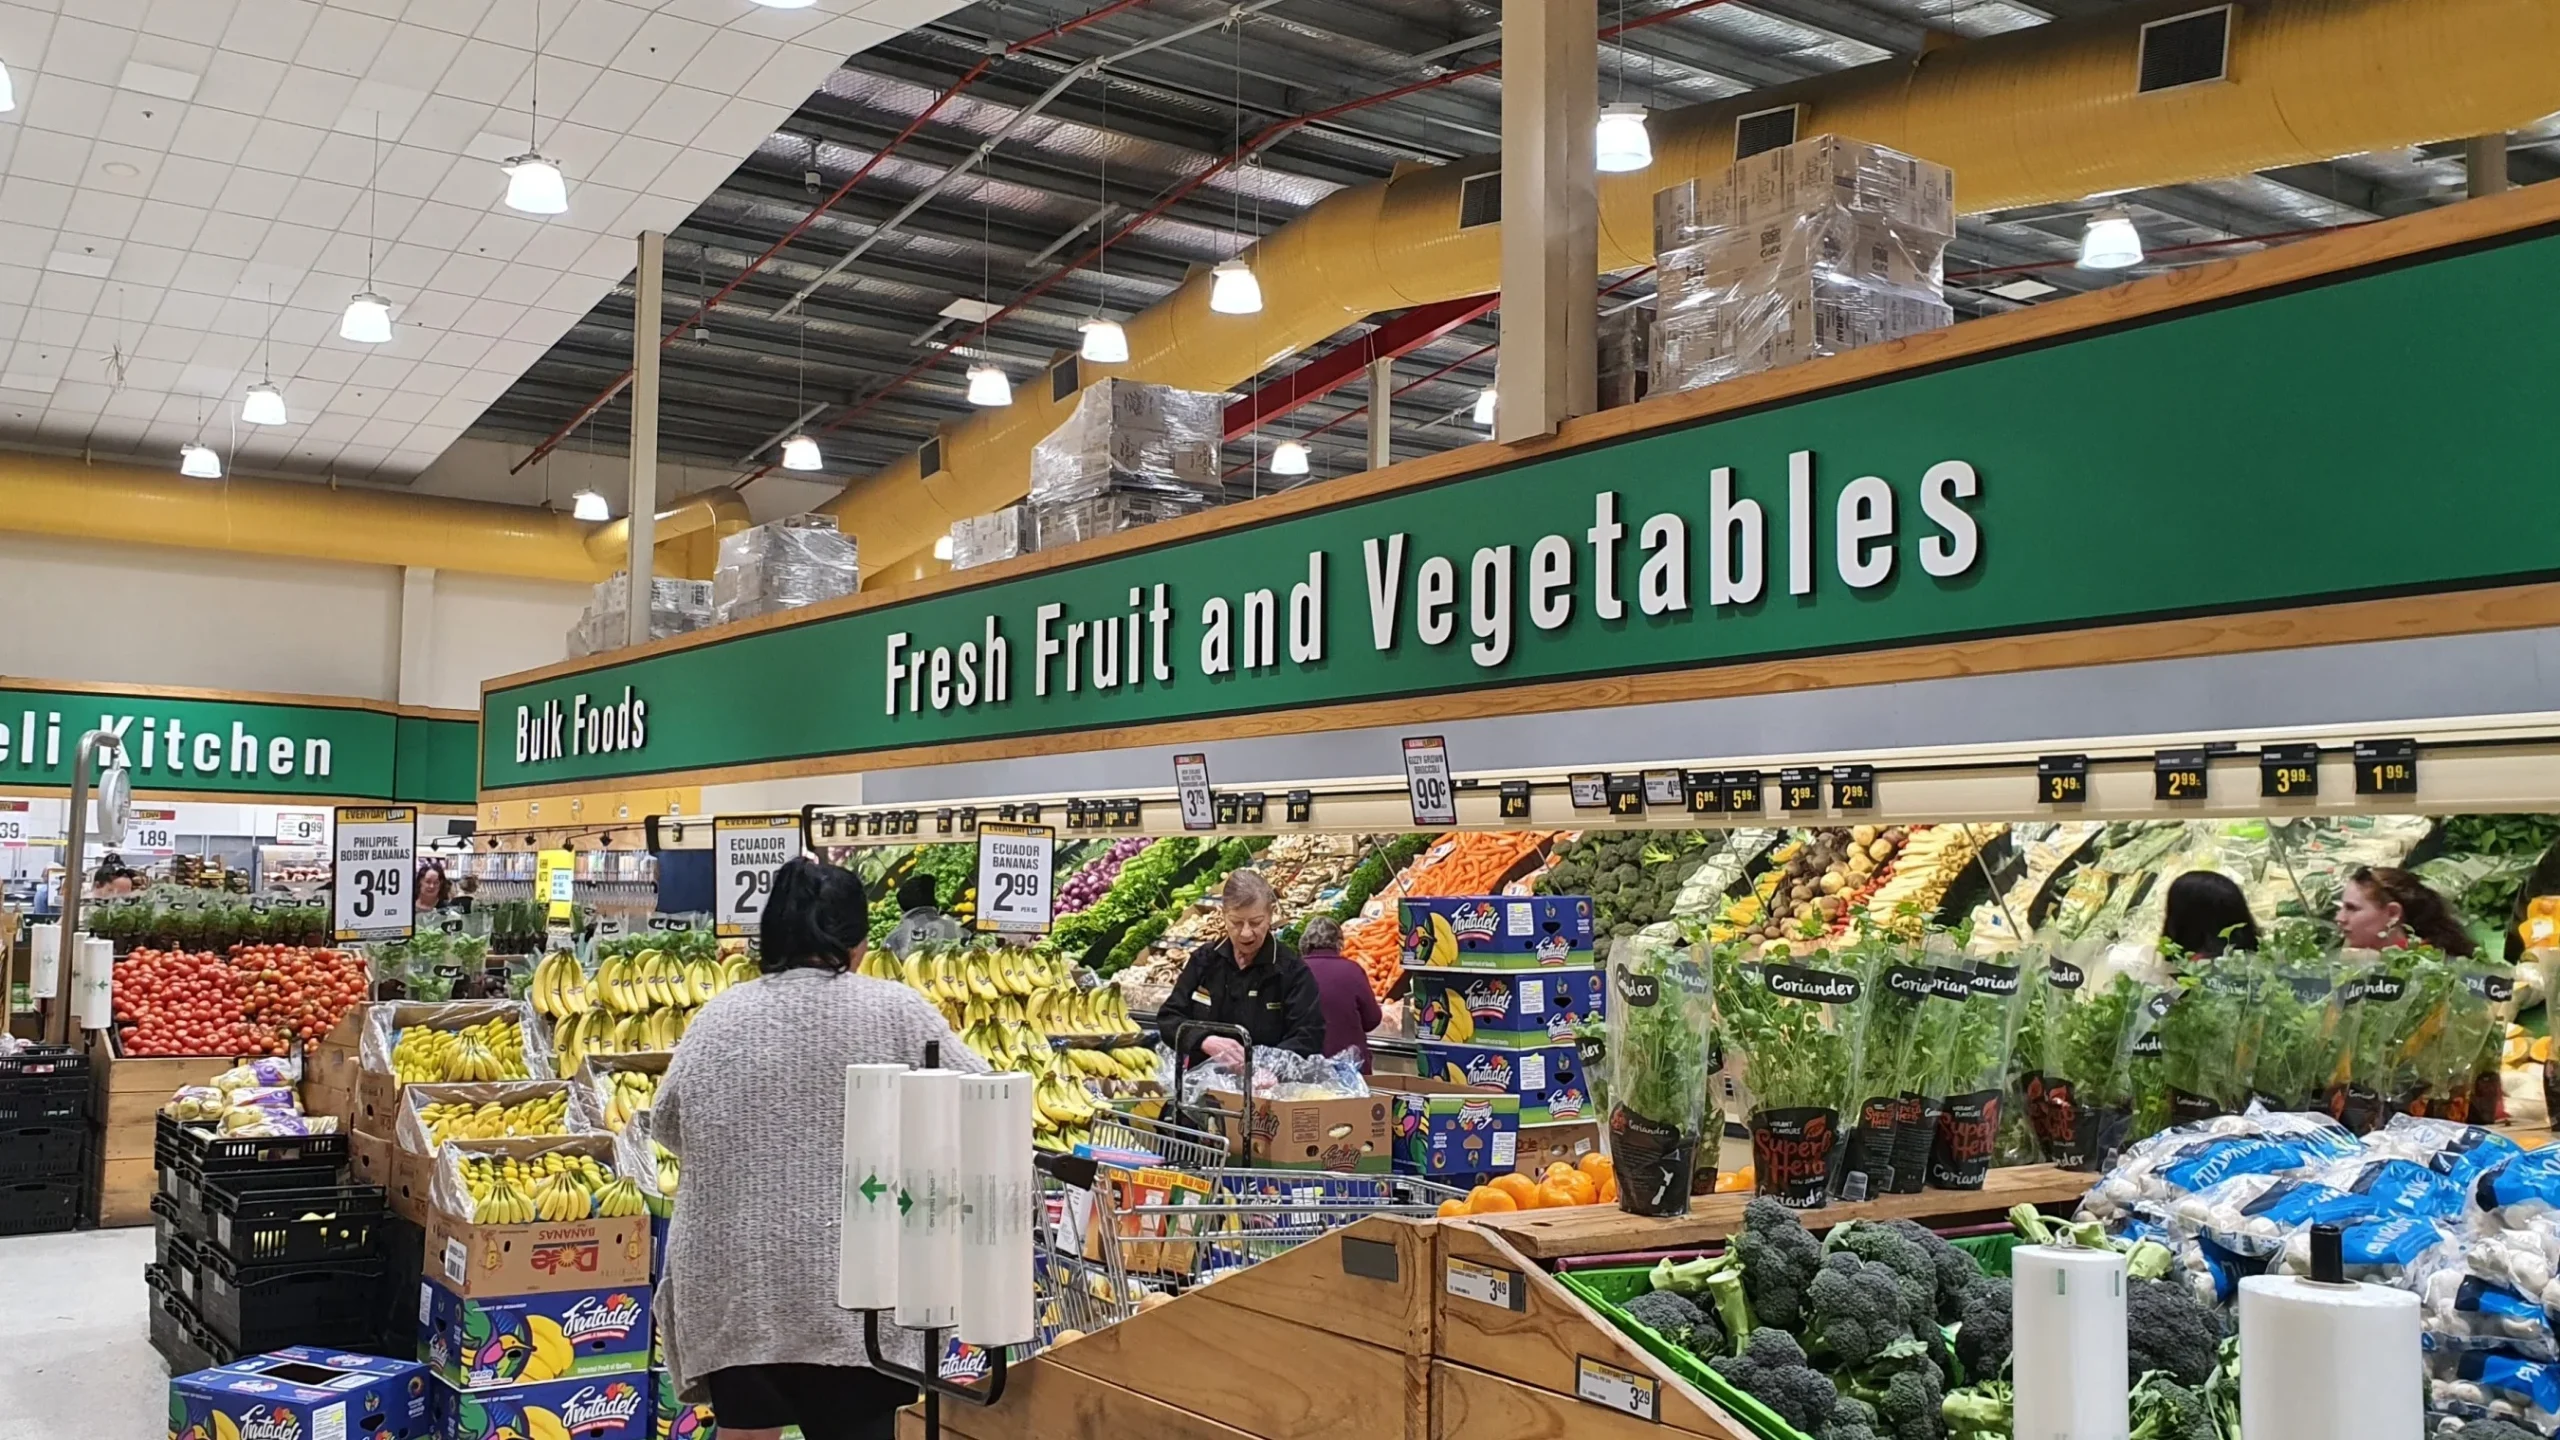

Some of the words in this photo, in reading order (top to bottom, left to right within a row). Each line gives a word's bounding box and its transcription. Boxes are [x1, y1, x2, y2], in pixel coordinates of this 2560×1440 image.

[886, 609, 1008, 718] Fresh
[1034, 583, 1172, 697] Fruit
[1200, 550, 1325, 676] and
[1362, 449, 1981, 669] Vegetables
[516, 699, 563, 763] Bulk
[573, 685, 645, 756] Foods
[98, 713, 332, 776] Kitchen
[2169, 772, 2197, 795] 299
[2277, 768, 2306, 793] 399
[2373, 765, 2404, 790] 199
[138, 830, 167, 847] 1.89
[298, 821, 322, 838] 999
[340, 849, 370, 862] BOBBY
[371, 848, 411, 861] BANANAS
[730, 837, 786, 852] ECUADOR
[992, 842, 1041, 858] ECUADOR
[731, 852, 785, 866] BANANAS
[992, 856, 1040, 871] BANANAS
[353, 868, 401, 918] 349
[734, 869, 779, 914] 29
[993, 872, 1039, 912] 299
[1771, 973, 1855, 998] Coriander
[1629, 1120, 1670, 1135] Coriander
[539, 1227, 595, 1240] BANANAS
[530, 1246, 599, 1275] Dole
[1489, 1279, 1507, 1301] 349
[562, 1296, 642, 1338] Frutadeli
[561, 1386, 642, 1429] Frutadeli
[1629, 1386, 1650, 1410] 329
